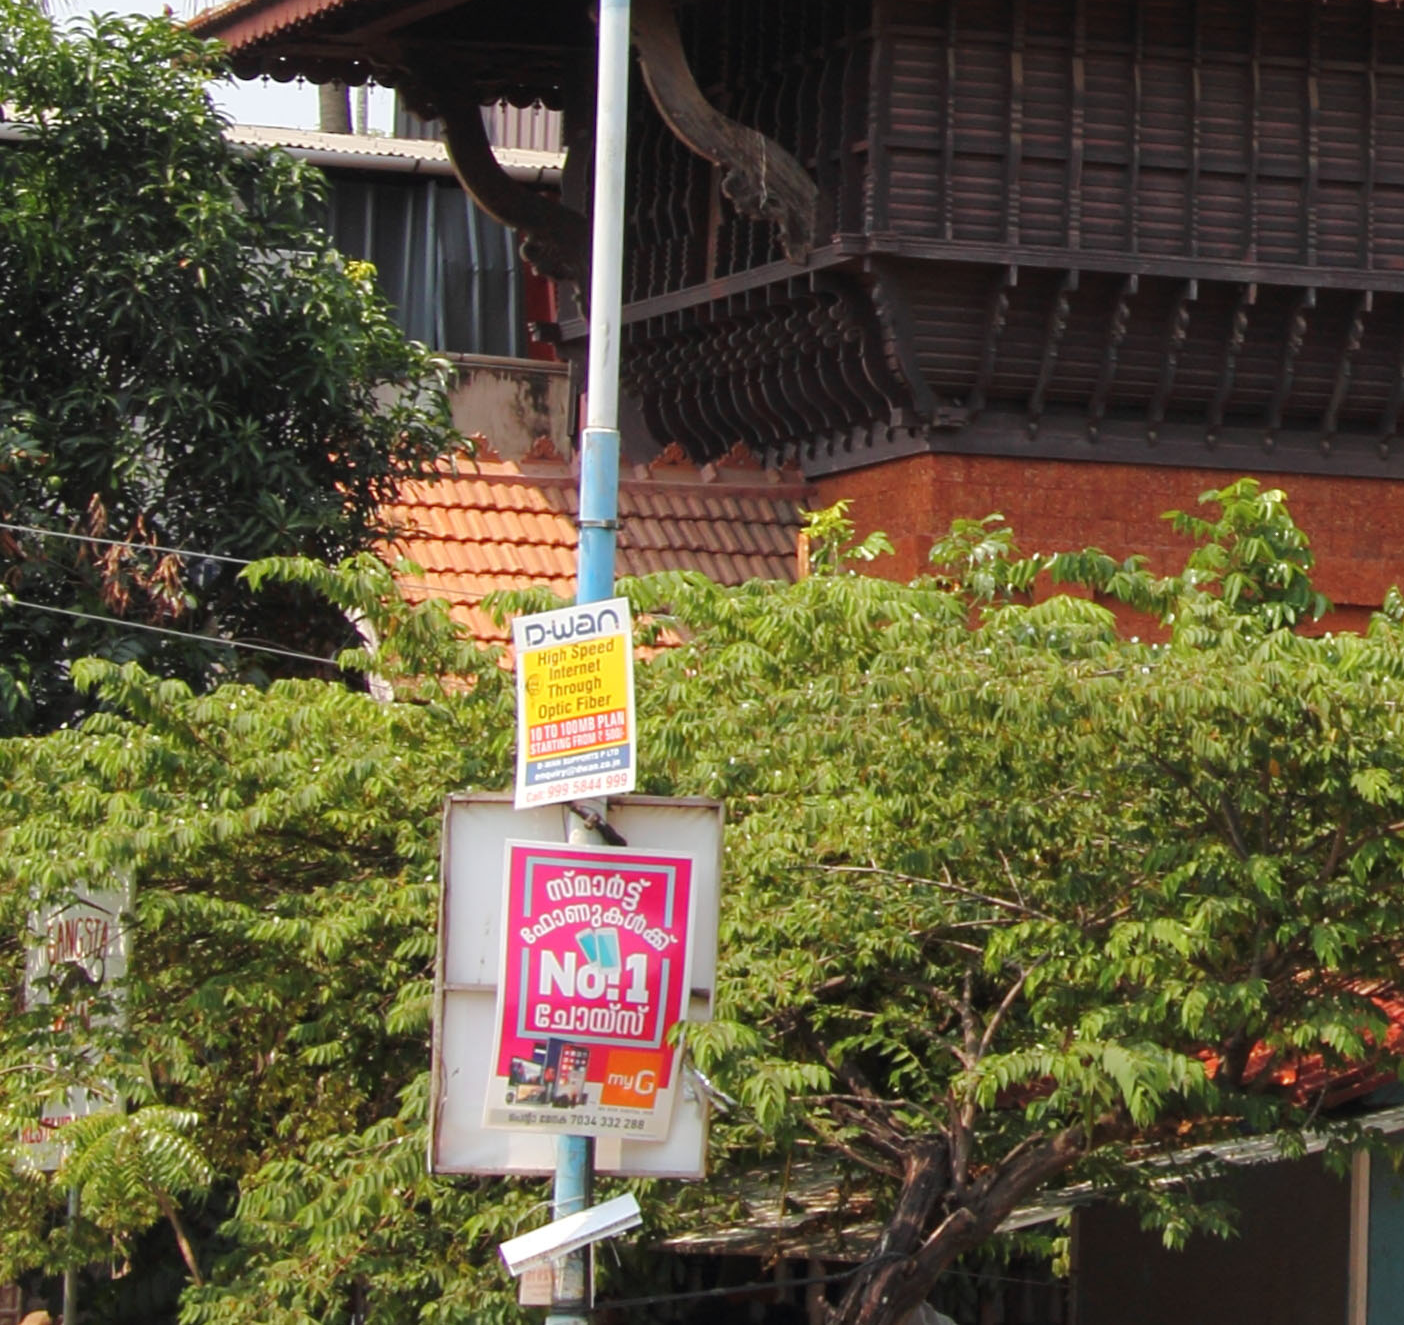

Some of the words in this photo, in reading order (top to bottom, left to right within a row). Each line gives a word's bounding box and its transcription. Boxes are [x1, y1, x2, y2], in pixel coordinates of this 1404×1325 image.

[537, 648, 568, 668] High
[571, 639, 615, 662] Speed
[548, 659, 601, 681] Internet
[547, 676, 602, 699] Through
[538, 700, 574, 720] Optic
[576, 694, 612, 711] Fiber
[530, 727, 543, 742] 10
[544, 723, 559, 740] TO
[561, 716, 596, 736] 100MB
[597, 711, 625, 728] PLAN
[530, 737, 572, 756] STARTING
[573, 732, 597, 747] FROM
[607, 749, 620, 758] LTD
[548, 784, 569, 799] 999
[573, 777, 602, 794] 5844
[605, 772, 628, 788] 999
[546, 870, 652, 911] സ്മാർട്ട്
[520, 903, 678, 951] ഫോണുകൾക്ക്
[607, 1069, 656, 1096] myG
[571, 1114, 598, 1127] 7034
[600, 1116, 621, 1129] 332
[623, 1118, 646, 1131] 288
